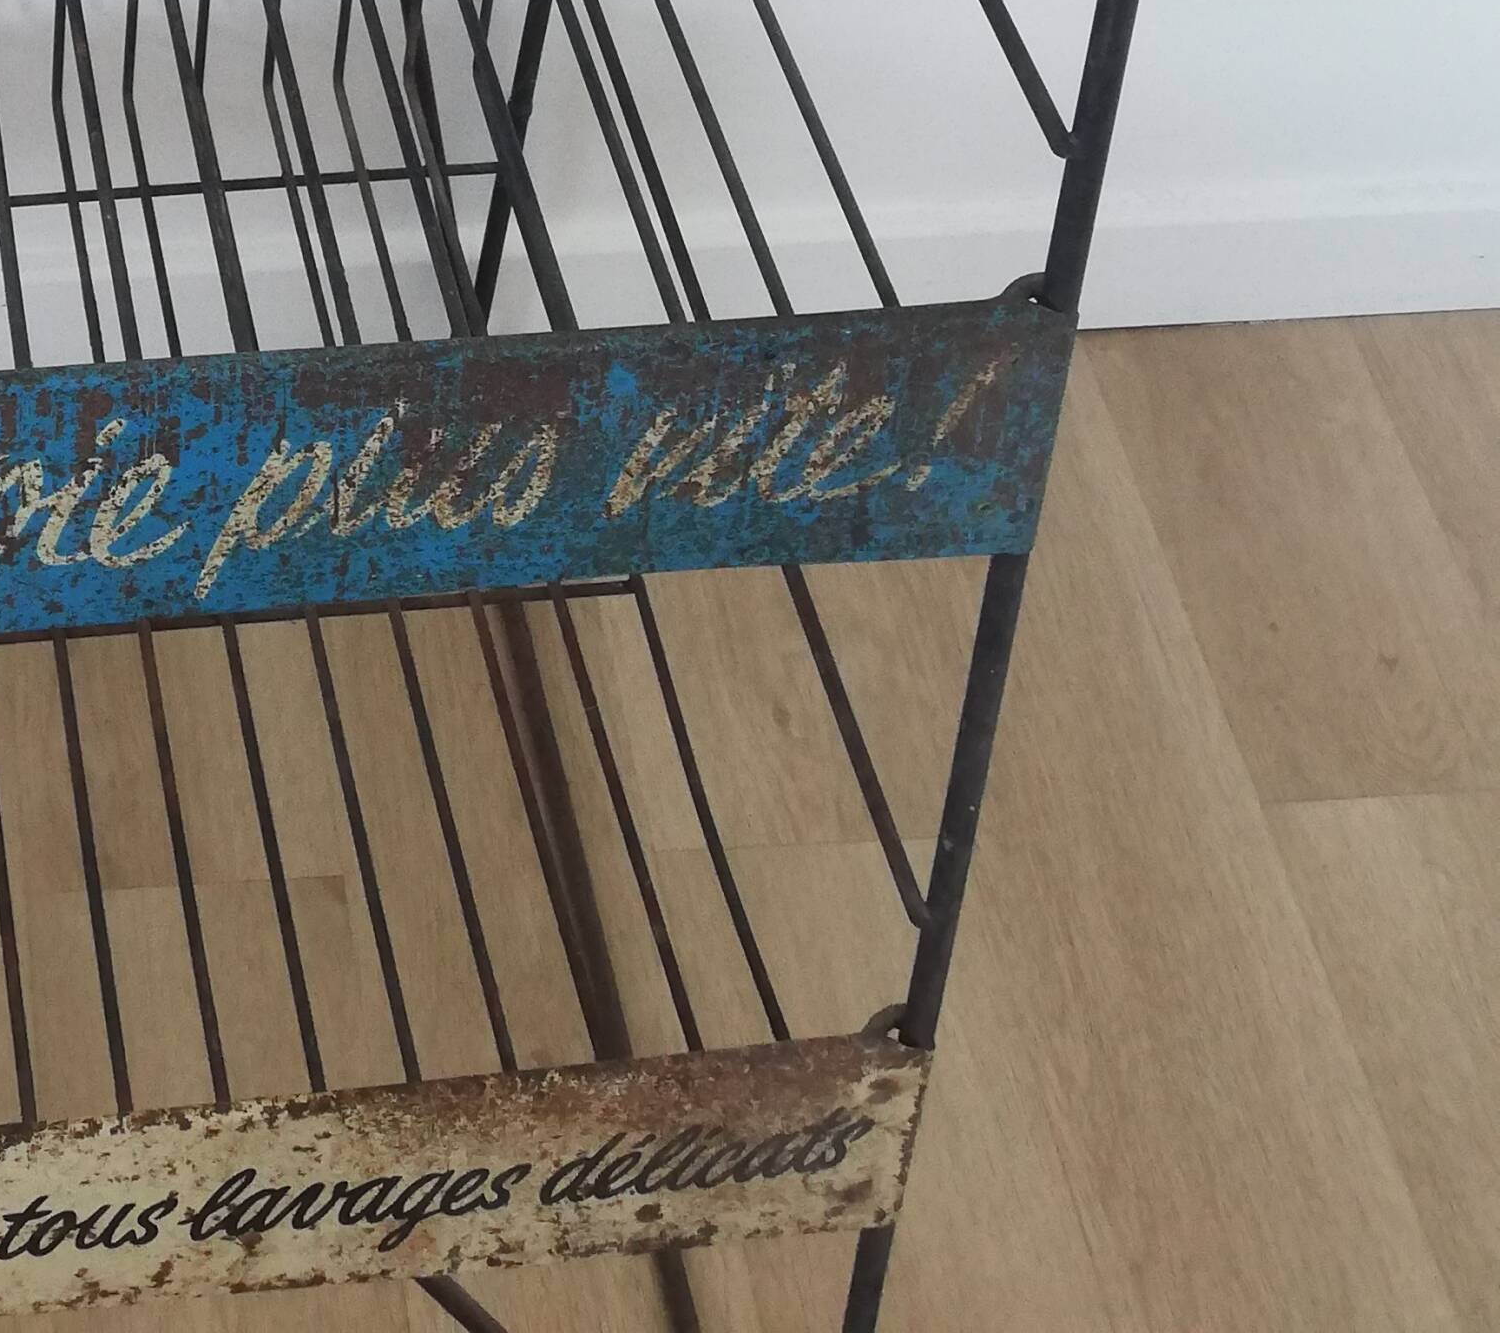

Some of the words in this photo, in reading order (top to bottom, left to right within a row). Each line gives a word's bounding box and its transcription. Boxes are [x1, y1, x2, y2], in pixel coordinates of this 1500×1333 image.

[193, 401, 556, 600] plus
[187, 1160, 531, 1252] lavages
[540, 1105, 874, 1206] délicats
